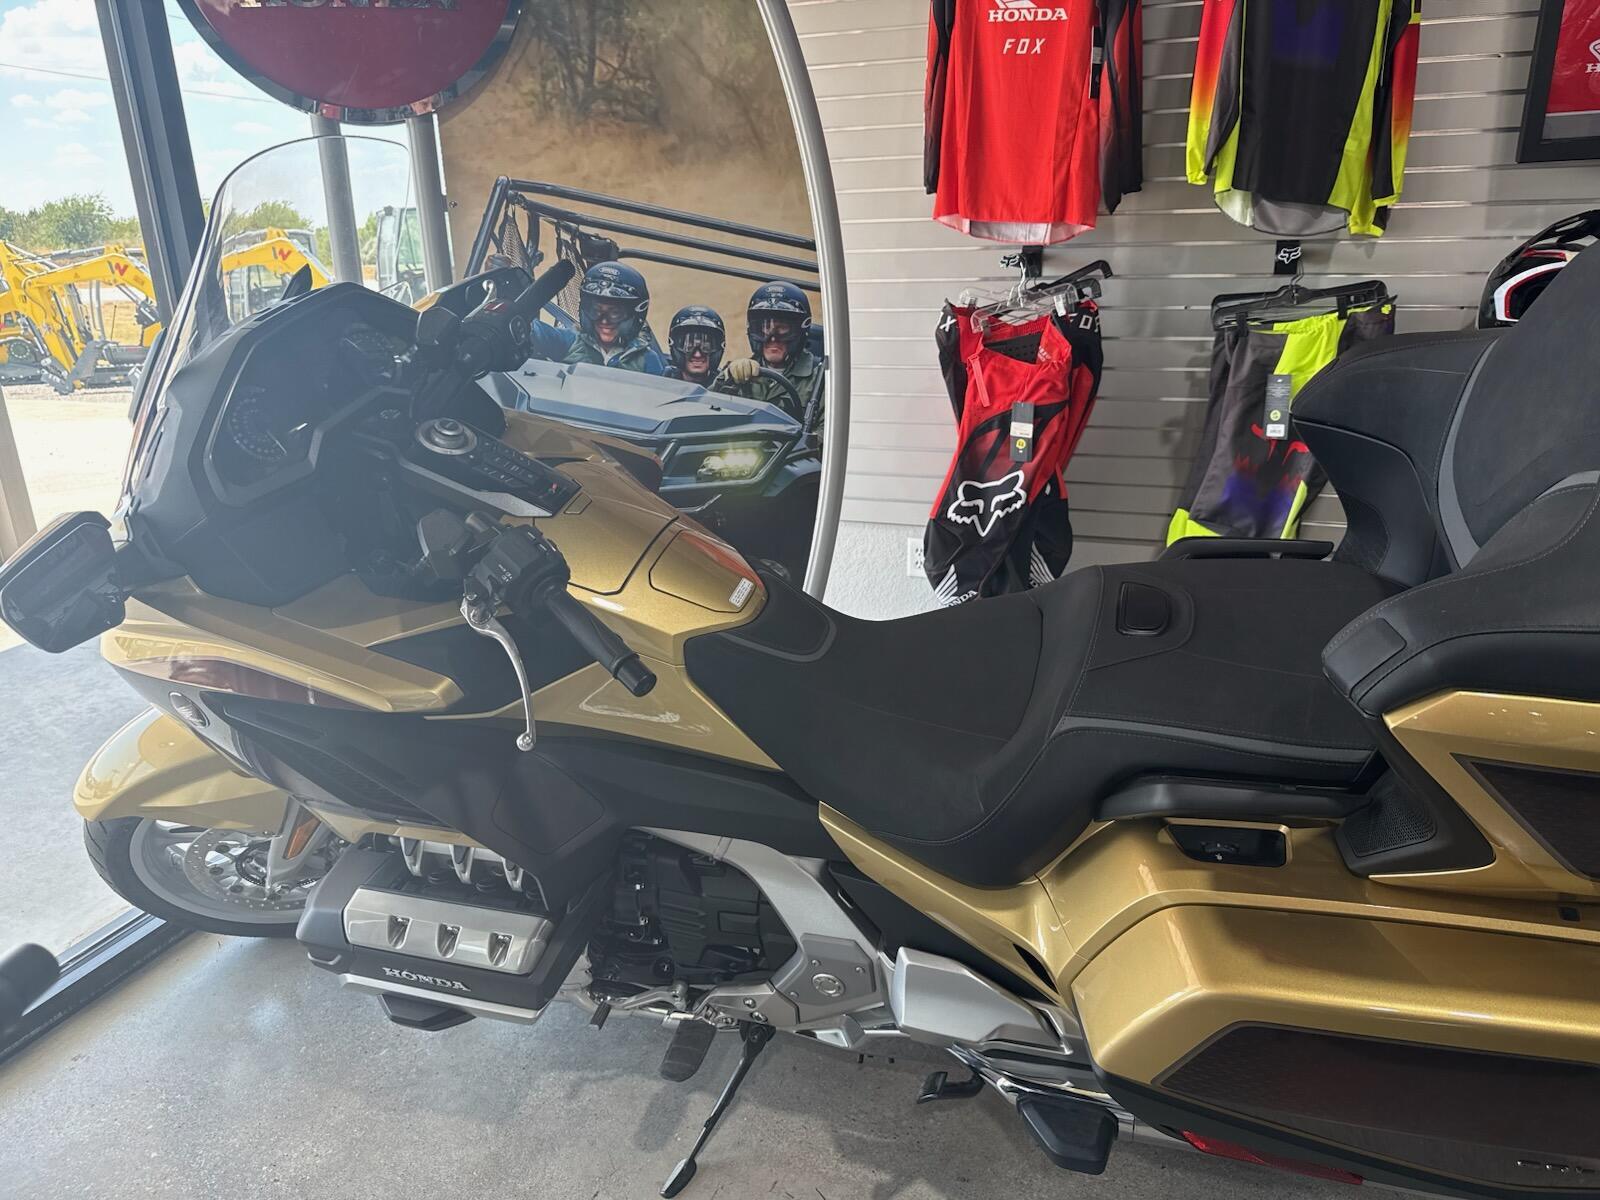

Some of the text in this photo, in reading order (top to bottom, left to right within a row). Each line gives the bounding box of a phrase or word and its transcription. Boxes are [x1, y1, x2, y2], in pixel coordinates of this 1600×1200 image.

[988, 8, 1068, 22] HONDA
[1003, 38, 1046, 54] FOX
[382, 967, 472, 992] HONDA
